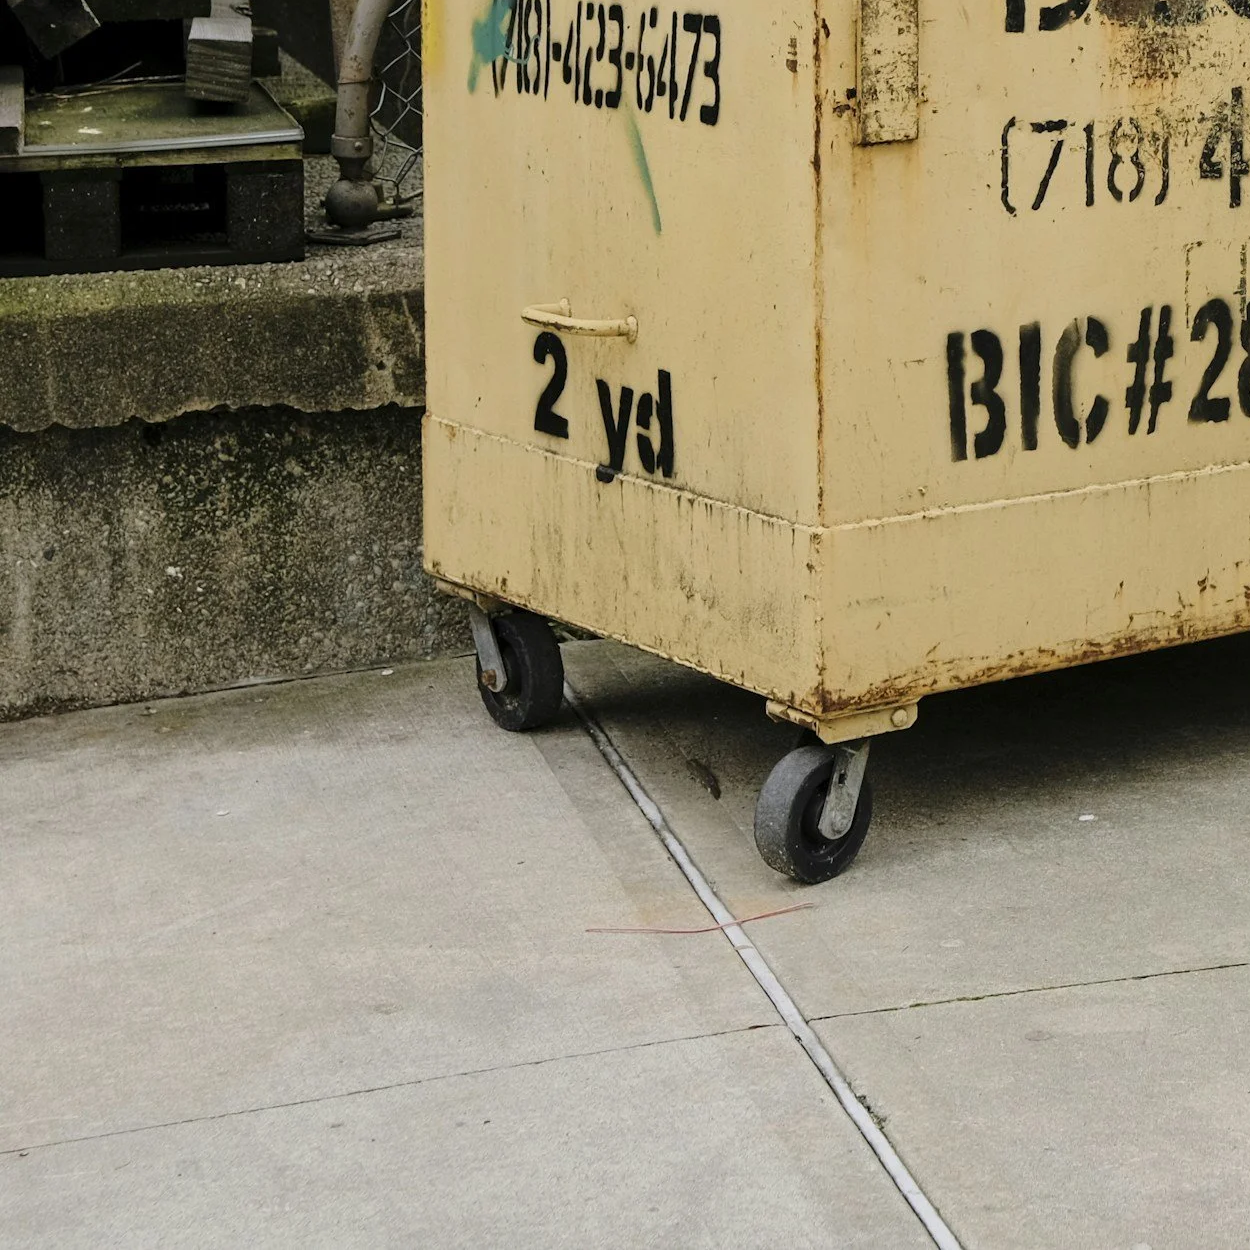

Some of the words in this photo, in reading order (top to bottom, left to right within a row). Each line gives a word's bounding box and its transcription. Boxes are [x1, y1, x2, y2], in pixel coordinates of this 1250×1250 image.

[1000, 116, 1171, 216] (718)
[533, 331, 569, 440] 2
[595, 368, 675, 484] yd
